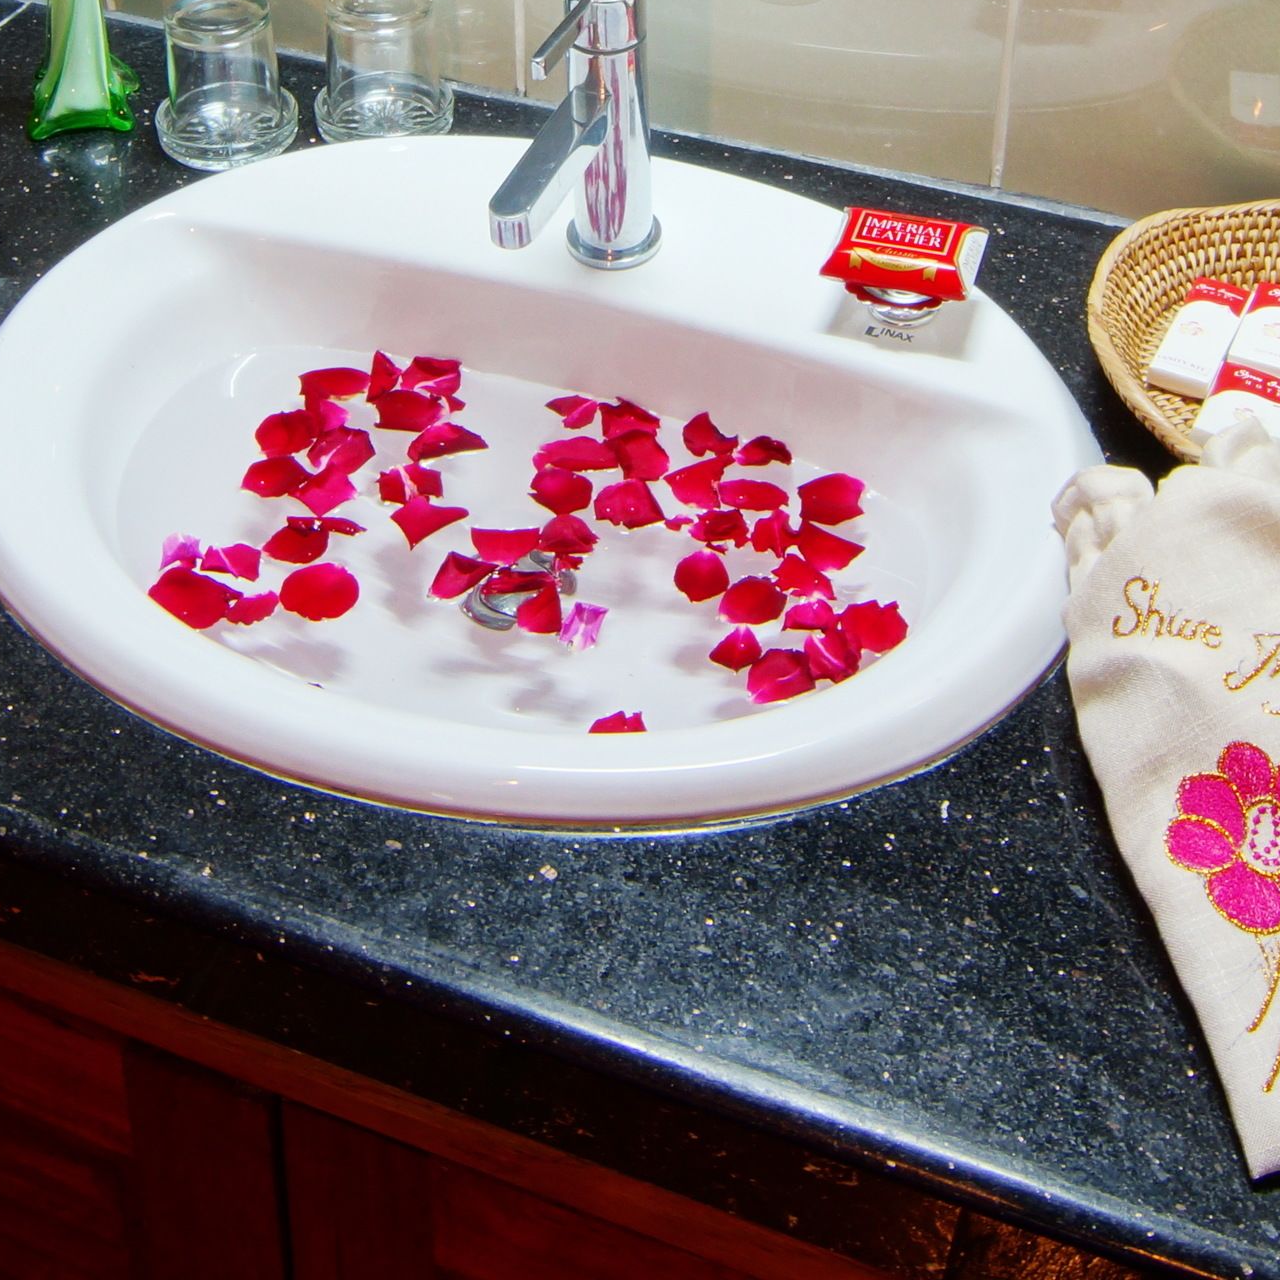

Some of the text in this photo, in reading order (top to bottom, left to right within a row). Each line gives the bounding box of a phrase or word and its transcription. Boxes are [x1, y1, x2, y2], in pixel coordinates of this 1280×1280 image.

[862, 227, 941, 248] LEATHER
[866, 216, 944, 238] IMPERIAL
[1112, 576, 1222, 649] Shwe
